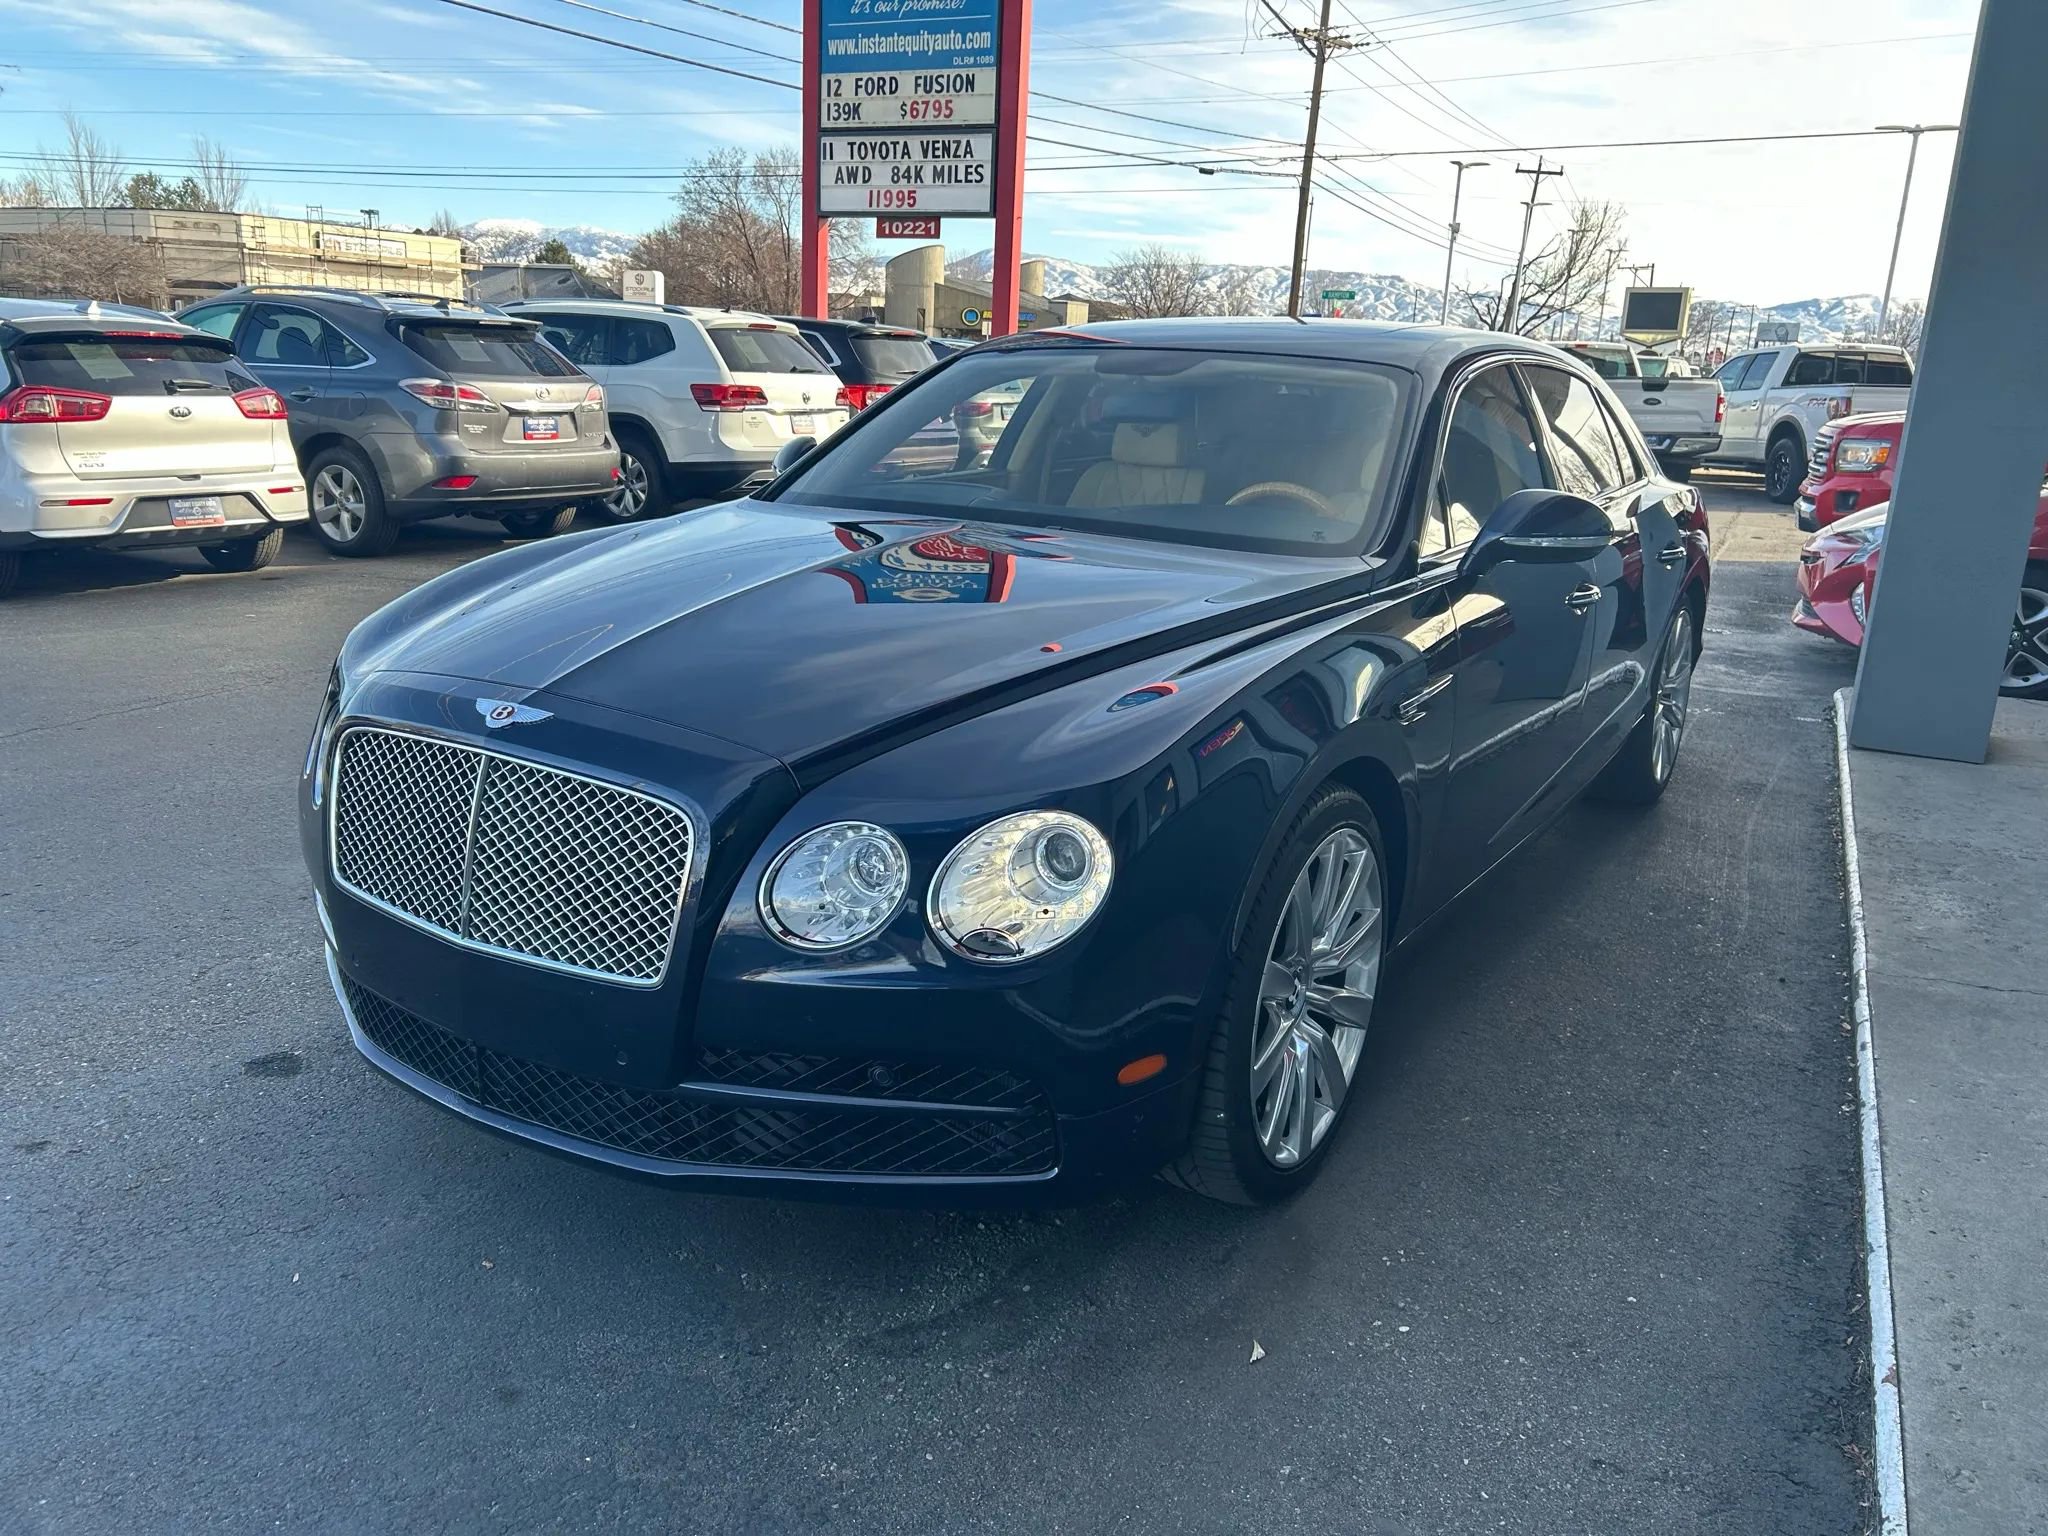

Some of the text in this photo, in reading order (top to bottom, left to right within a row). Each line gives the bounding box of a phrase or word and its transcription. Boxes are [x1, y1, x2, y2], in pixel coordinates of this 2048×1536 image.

[850, 0, 965, 18] it's our promise!
[827, 29, 992, 56] www.instantequityauto.com
[952, 56, 975, 66] DLR#
[826, 73, 976, 98] 12 FORD FUSION
[826, 99, 954, 122] 139K $6795
[847, 140, 912, 161] TOYOTA
[920, 139, 975, 160] VENZA
[834, 163, 985, 185] AWD 84K MILES
[868, 189, 917, 209] 11995
[881, 220, 937, 236] 10221
